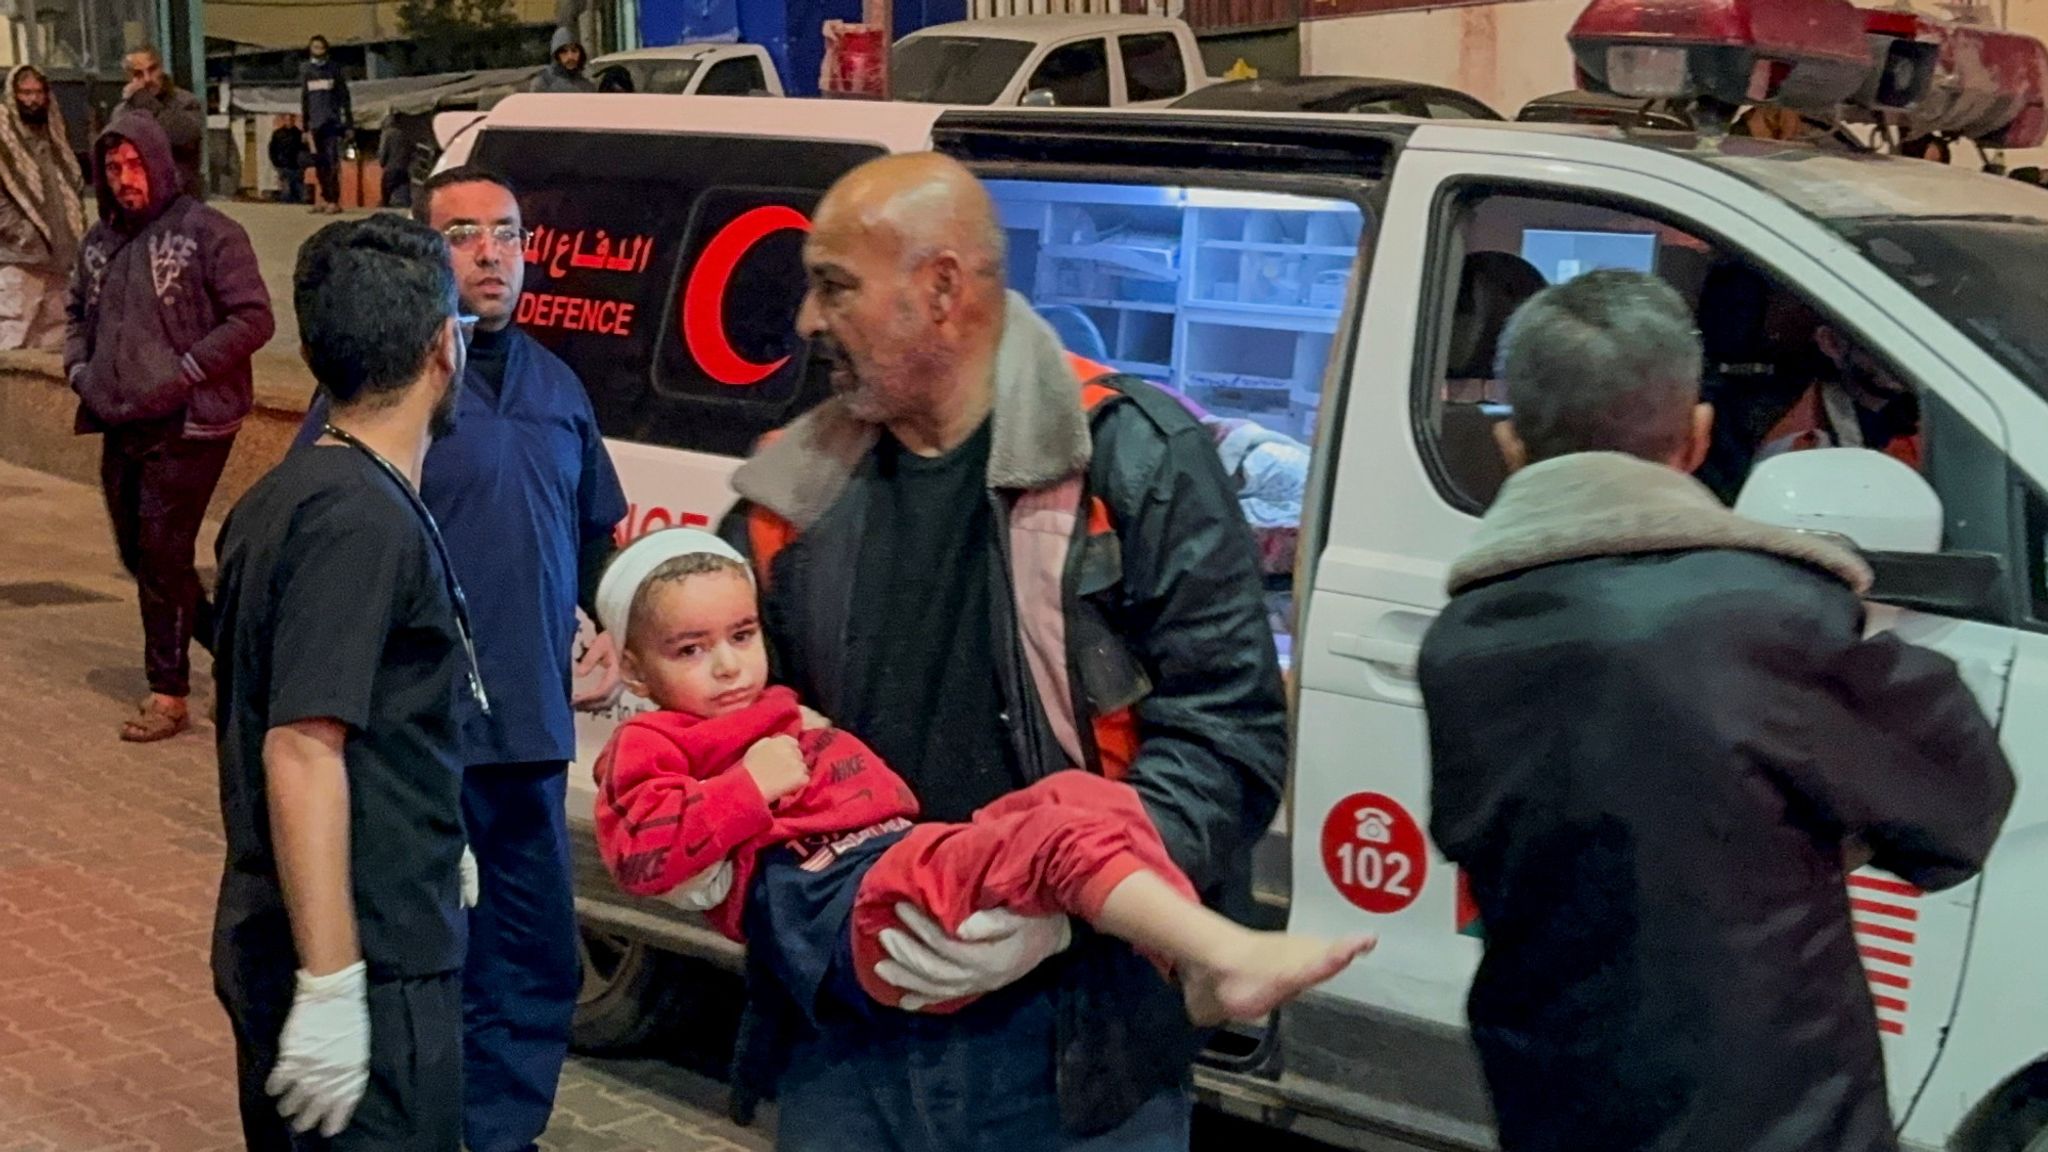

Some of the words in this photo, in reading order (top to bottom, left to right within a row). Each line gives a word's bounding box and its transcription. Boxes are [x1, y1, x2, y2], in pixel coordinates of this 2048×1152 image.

[549, 229, 654, 278] الدفاع
[516, 291, 635, 336] DEFENCE
[1337, 842, 1411, 897] 102
